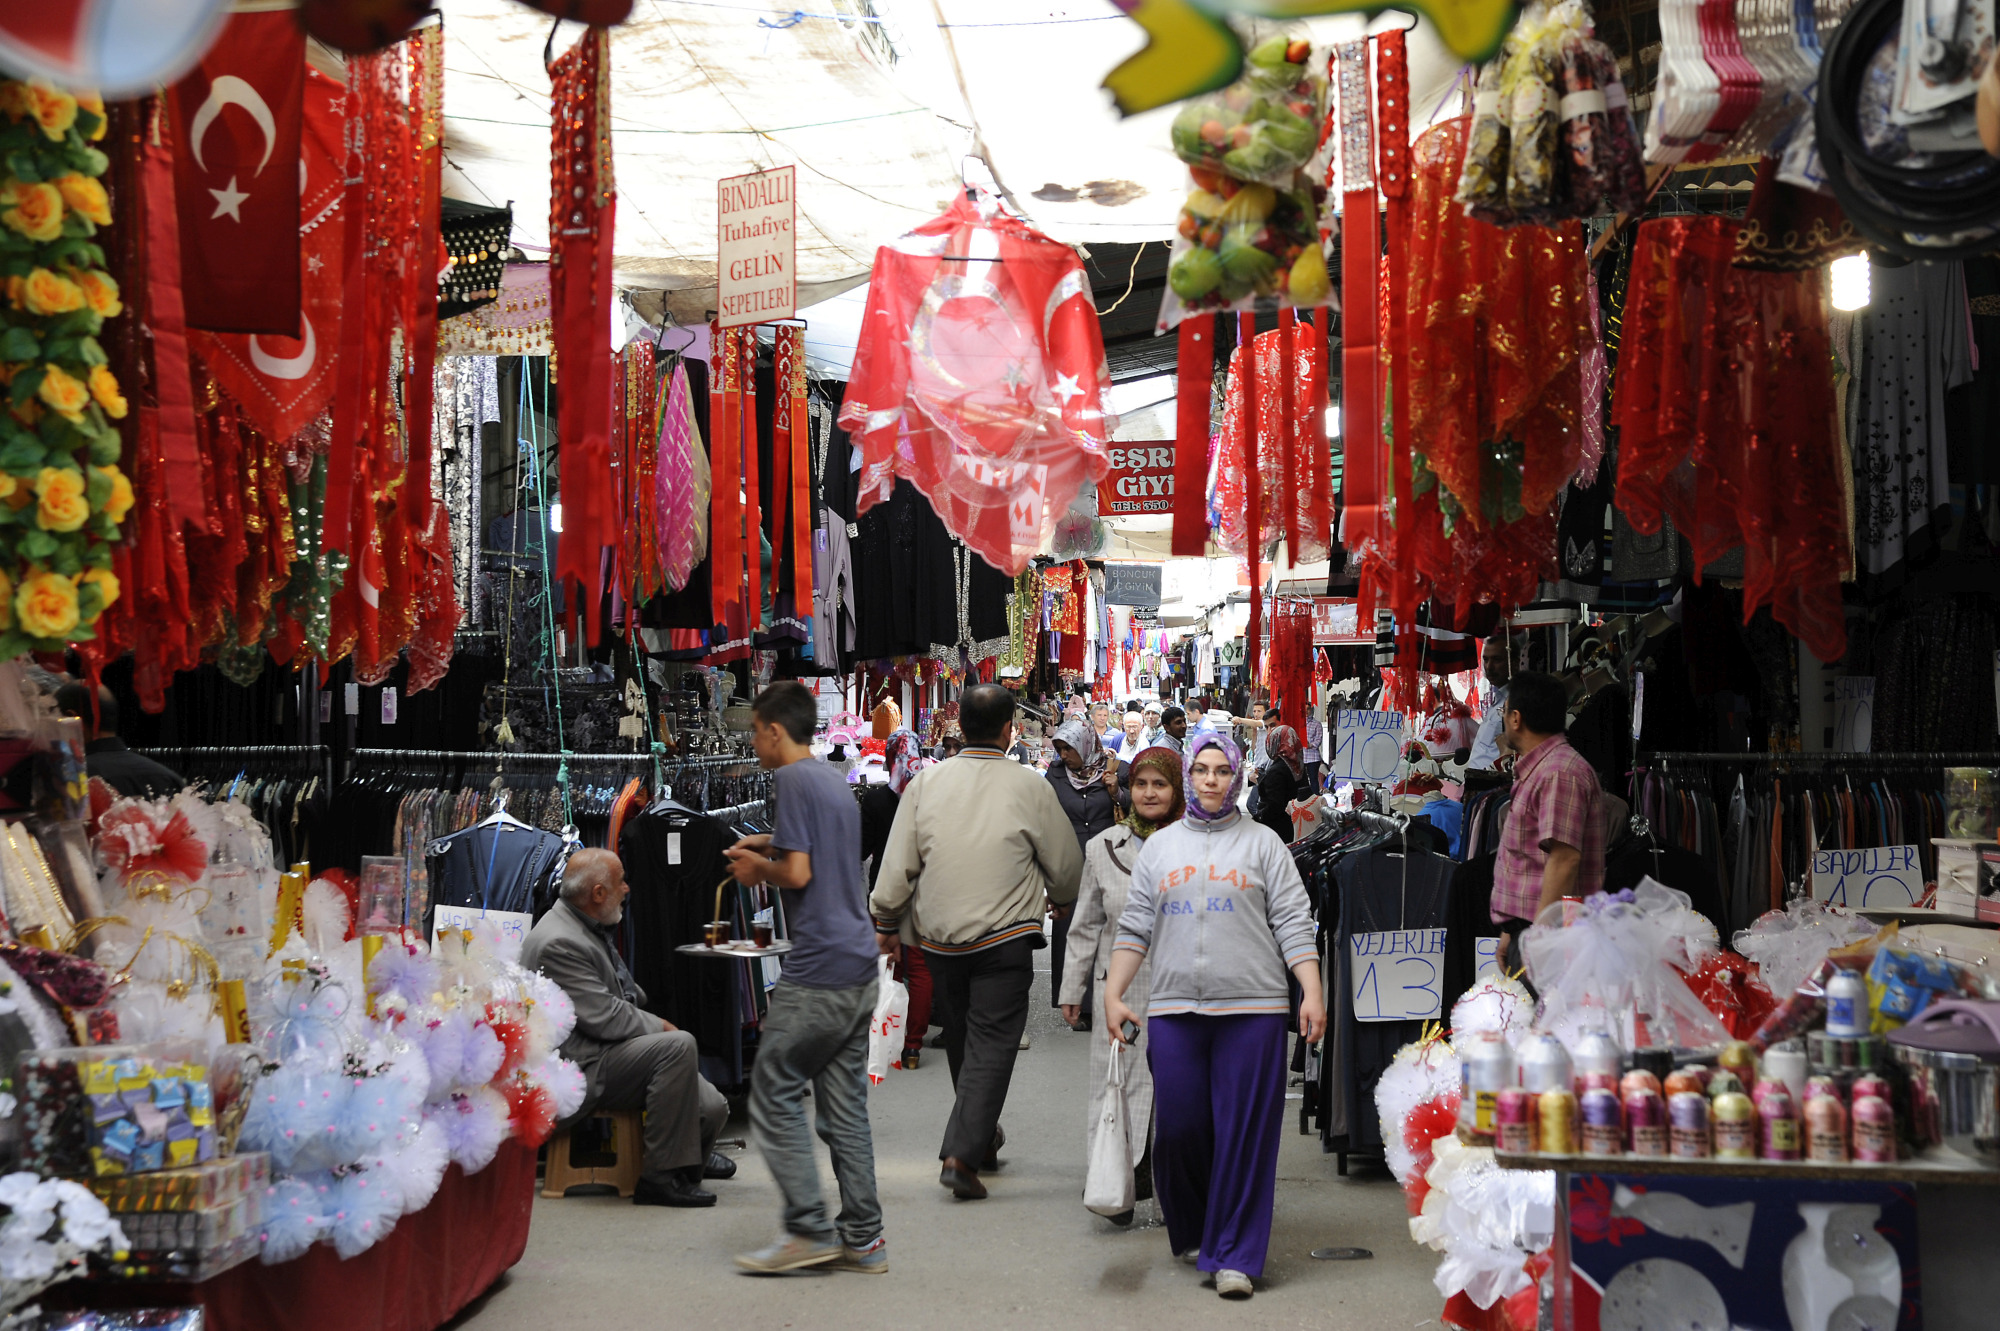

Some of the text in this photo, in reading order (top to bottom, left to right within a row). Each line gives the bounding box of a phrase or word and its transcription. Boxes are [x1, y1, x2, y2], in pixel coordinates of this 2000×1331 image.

[721, 174, 790, 214] BİNDALLI
[722, 216, 790, 242] Tuhafiye
[730, 250, 783, 281] GELİN
[722, 280, 790, 317] SEPETLERİ
[1111, 501, 1141, 511] TEL:
[1337, 709, 1403, 730] PENYELER
[1336, 732, 1399, 780] 10
[1357, 957, 1440, 1019] 13
